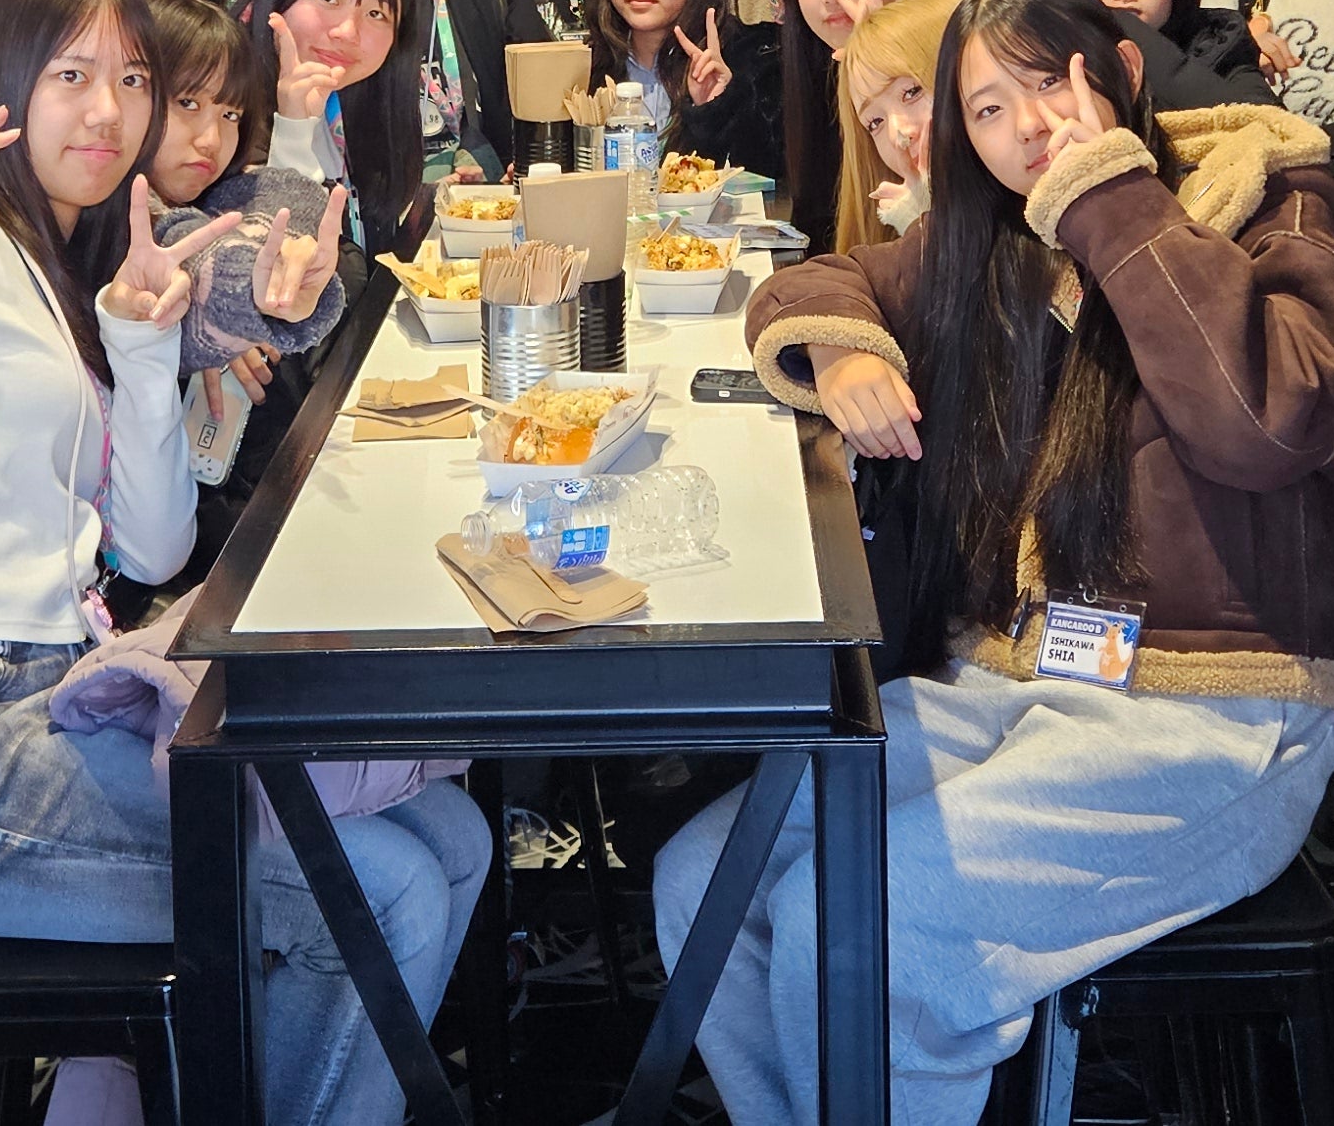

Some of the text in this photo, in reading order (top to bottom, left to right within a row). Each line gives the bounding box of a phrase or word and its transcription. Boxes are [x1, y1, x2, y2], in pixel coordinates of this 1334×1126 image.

[1050, 617, 1095, 632] KANGAROO
[1050, 636, 1095, 651] ISHIKAWA
[1047, 648, 1076, 663] SHIA
